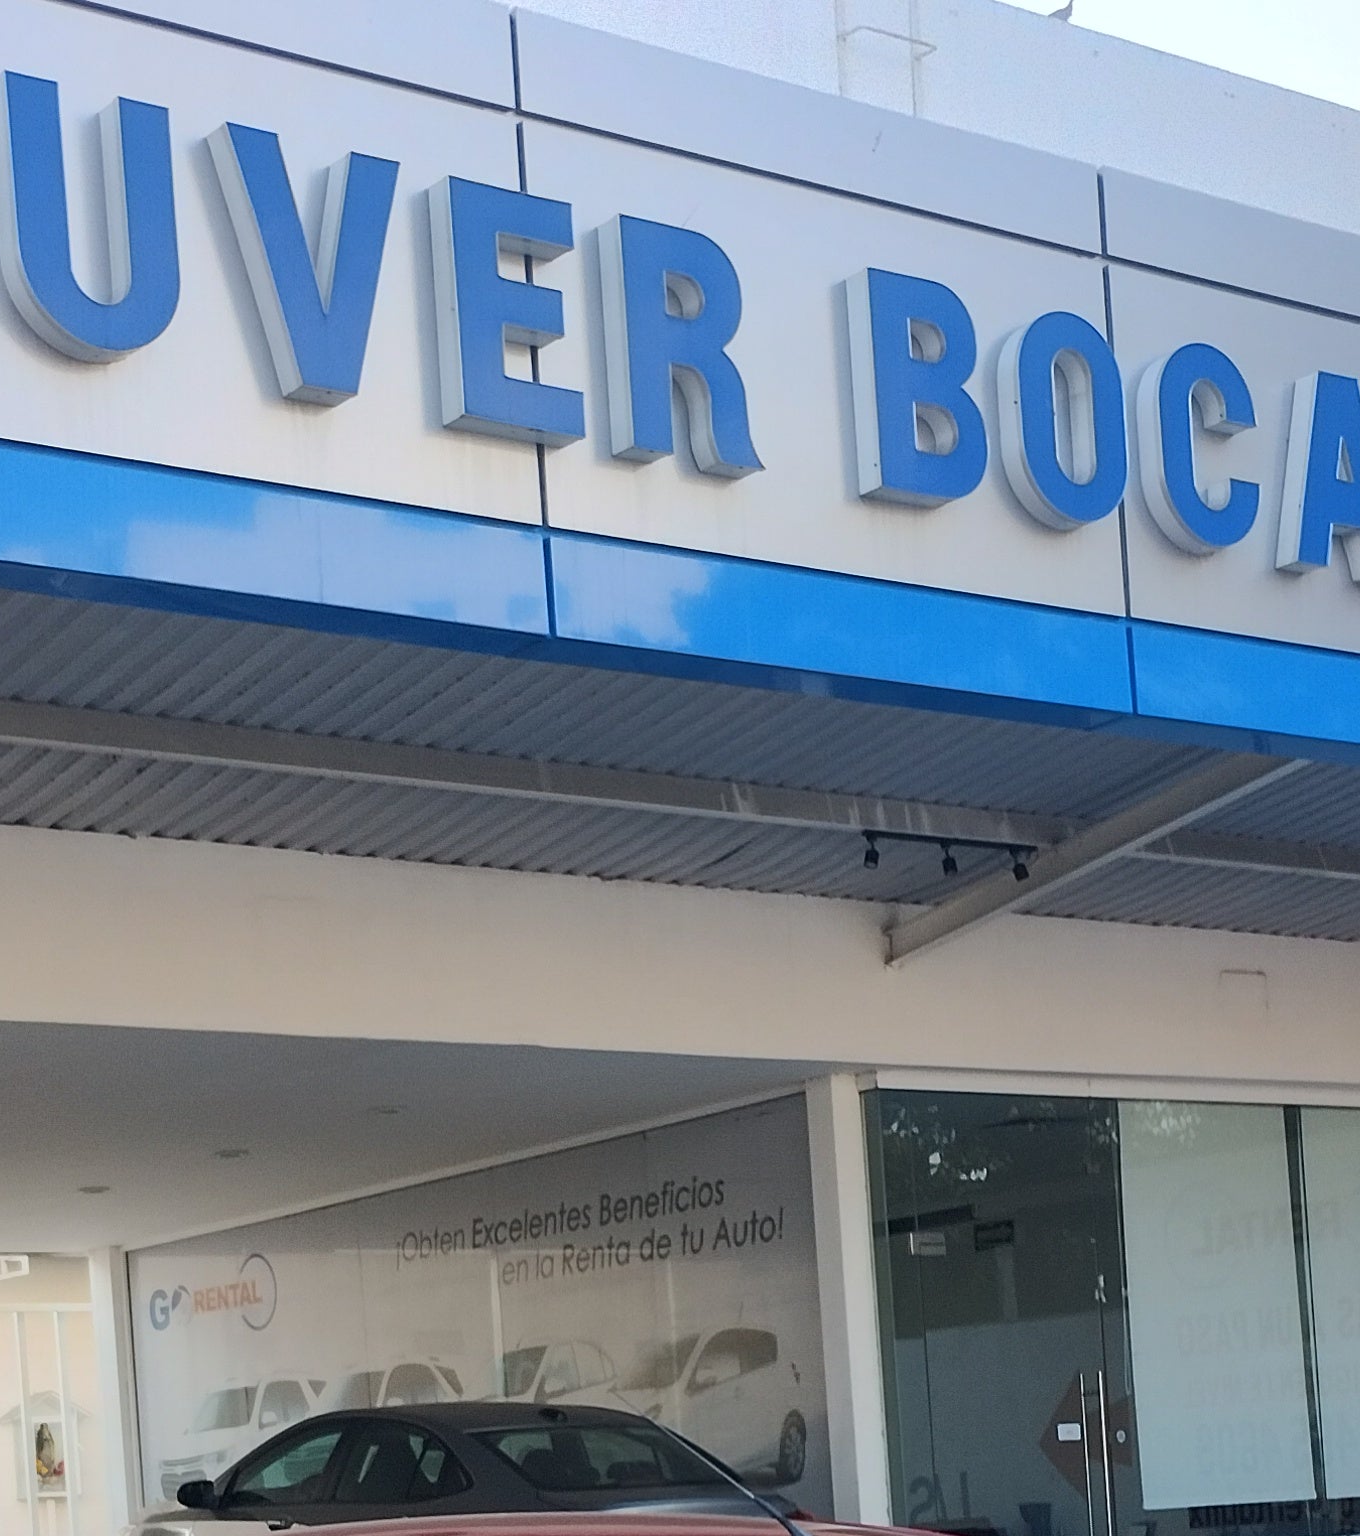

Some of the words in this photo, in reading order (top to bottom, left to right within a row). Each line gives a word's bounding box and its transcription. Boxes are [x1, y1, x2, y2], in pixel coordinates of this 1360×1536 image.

[471, 1201, 591, 1250] Excelentes
[598, 1175, 725, 1227] Beneficios
[501, 1258, 529, 1286] en
[536, 1254, 554, 1280] la
[561, 1235, 631, 1275] Renta
[640, 1228, 672, 1262] de
[681, 1221, 704, 1256] tu
[712, 1206, 784, 1251] Auto!
[192, 1279, 264, 1314] RENTAL
